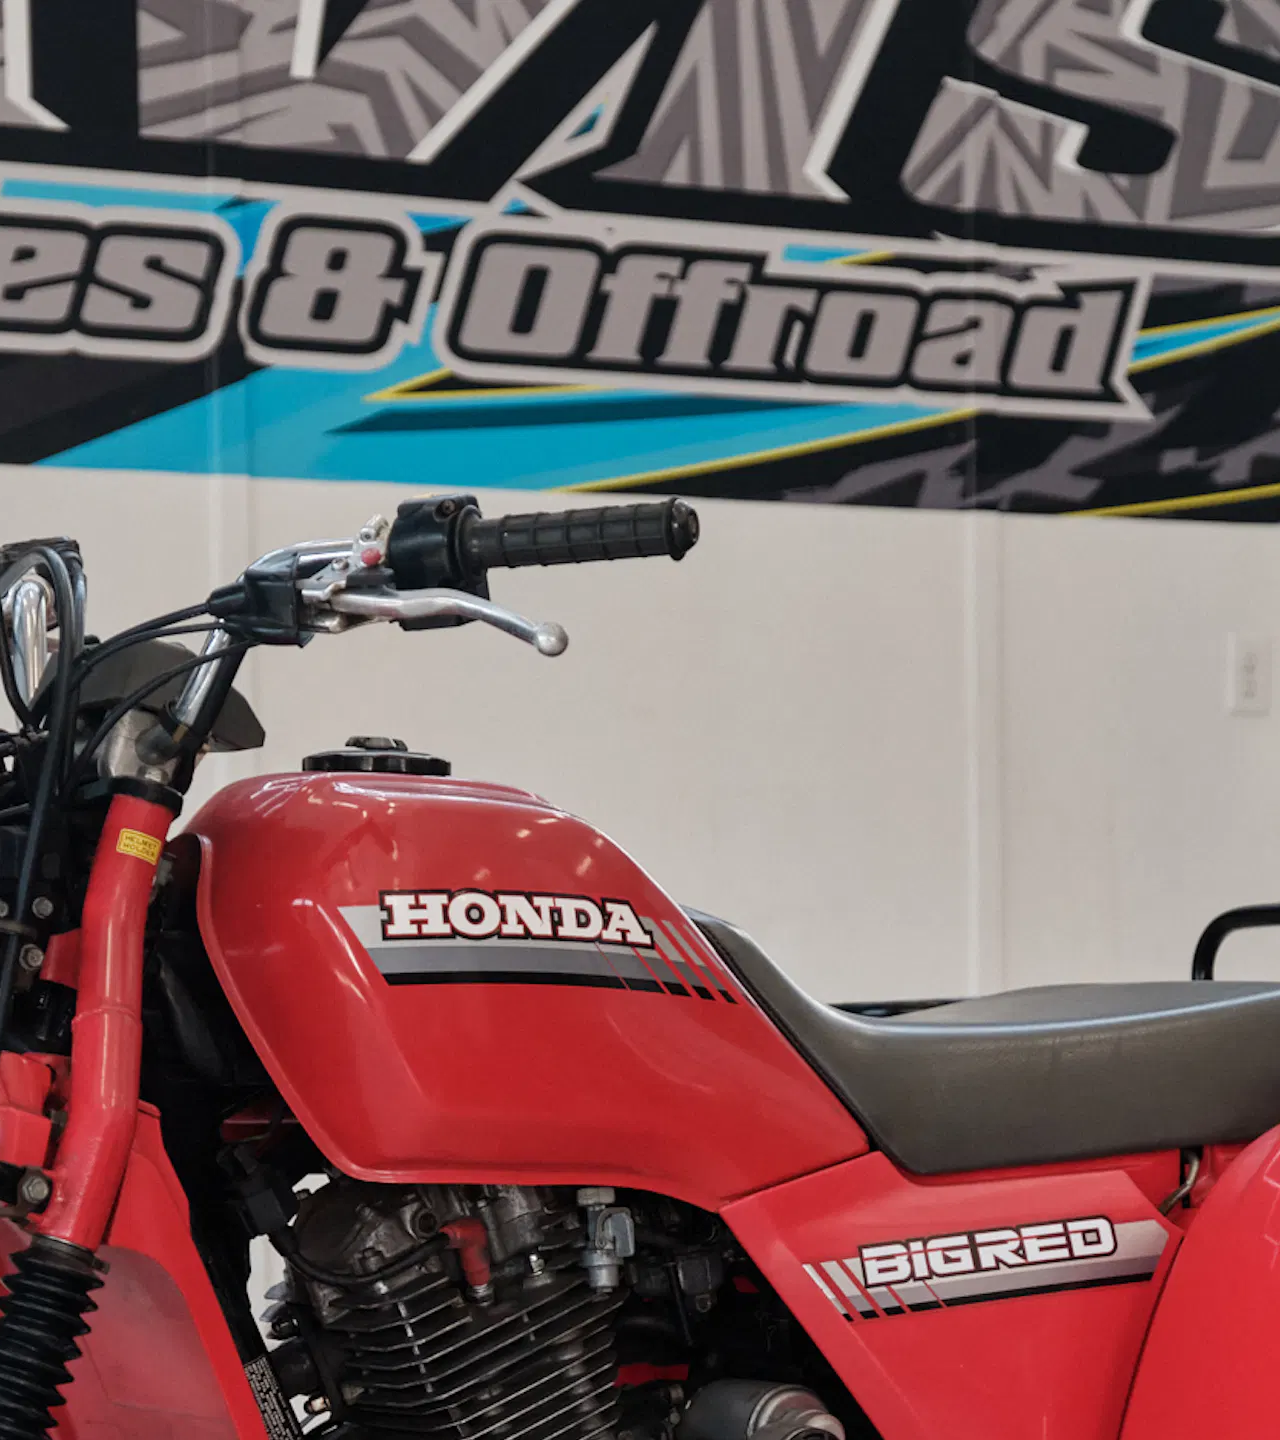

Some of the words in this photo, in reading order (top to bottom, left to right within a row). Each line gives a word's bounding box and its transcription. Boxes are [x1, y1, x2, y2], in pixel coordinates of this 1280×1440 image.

[256, 225, 407, 350] &
[455, 236, 1125, 393] Offroad
[380, 889, 654, 946] HONDA
